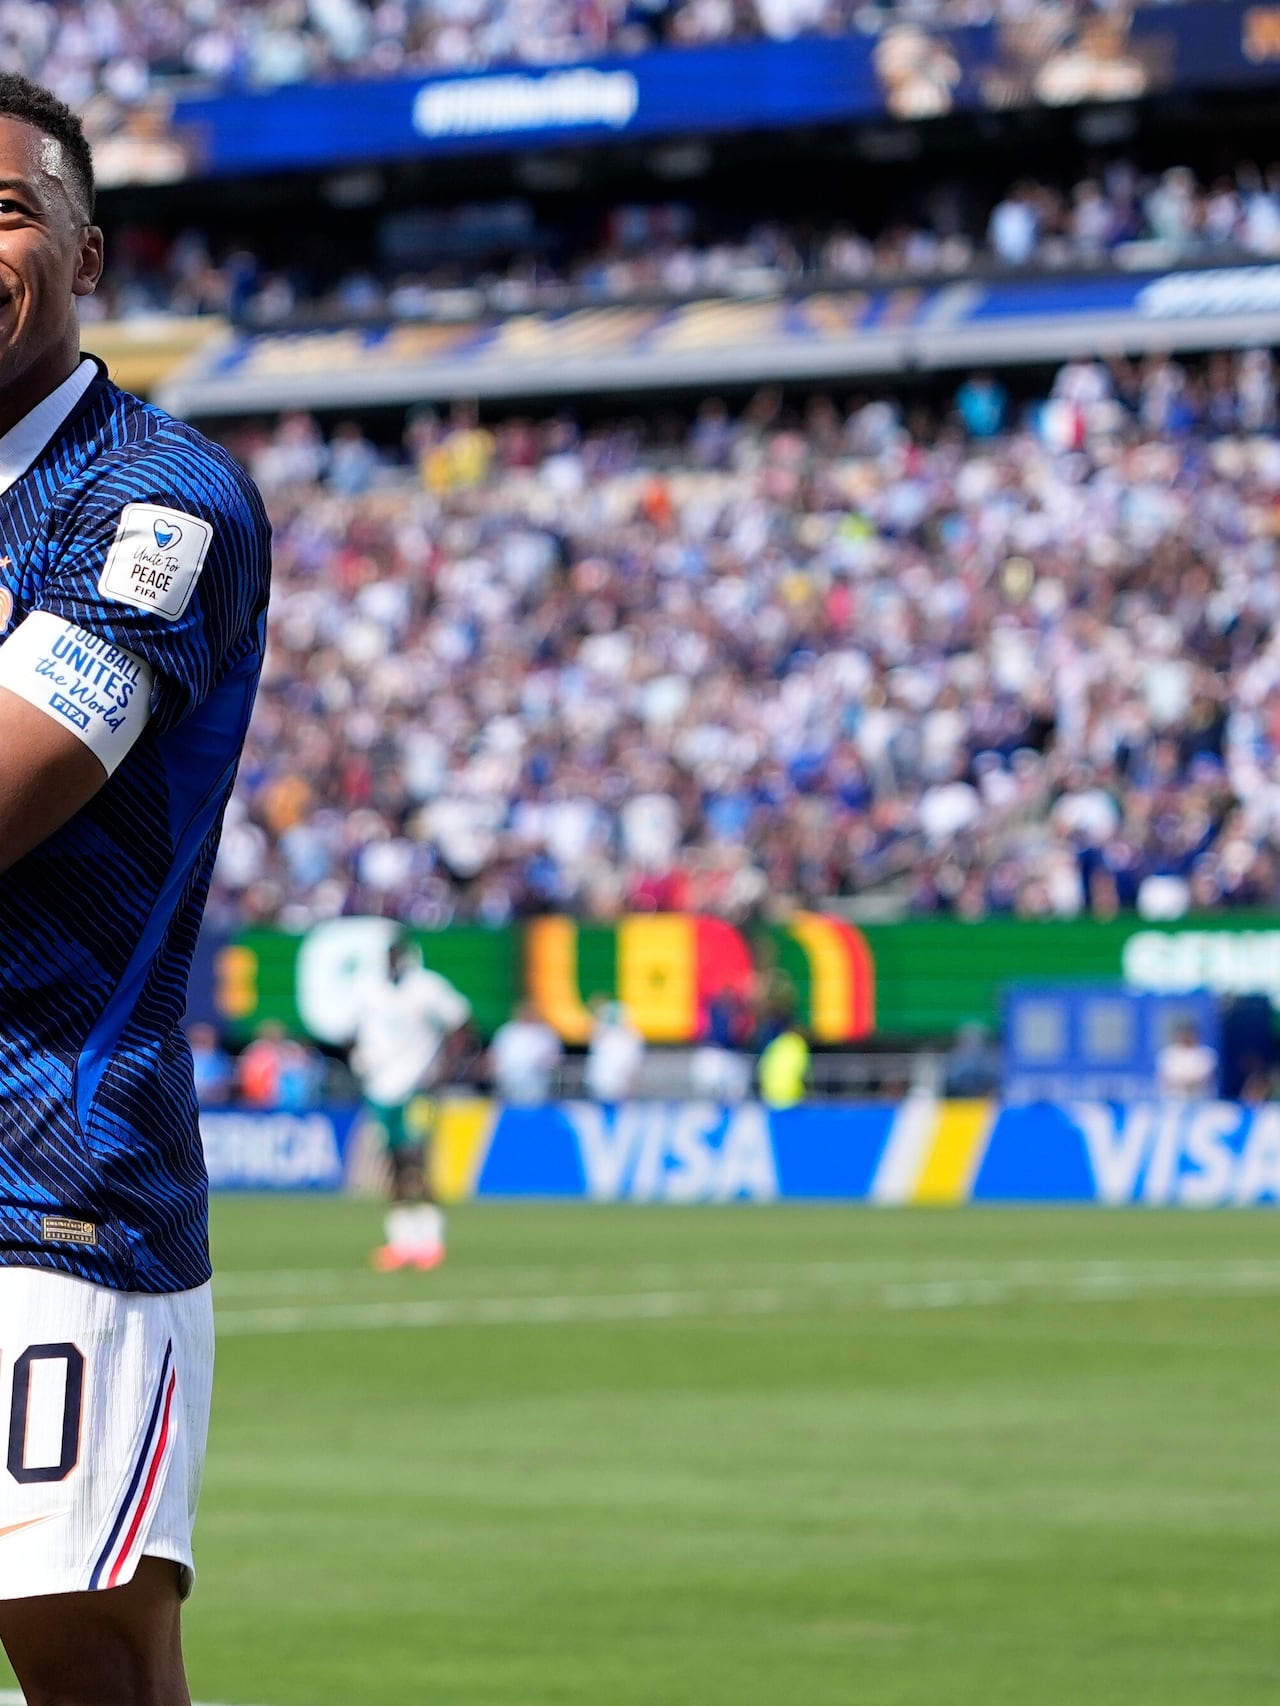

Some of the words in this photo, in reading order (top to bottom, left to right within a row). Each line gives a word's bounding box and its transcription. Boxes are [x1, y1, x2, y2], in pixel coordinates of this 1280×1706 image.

[130, 564, 173, 592] PEACE
[133, 545, 163, 567] Unite
[165, 556, 181, 573] For
[134, 585, 157, 600] FIFA
[51, 635, 134, 710] UNITES
[65, 623, 142, 687] FOOTBALL
[34, 656, 69, 686] the
[69, 678, 127, 734] World
[52, 697, 88, 728] FIFA
[568, 1105, 780, 1203] VISA
[1082, 1104, 1280, 1203] VISA
